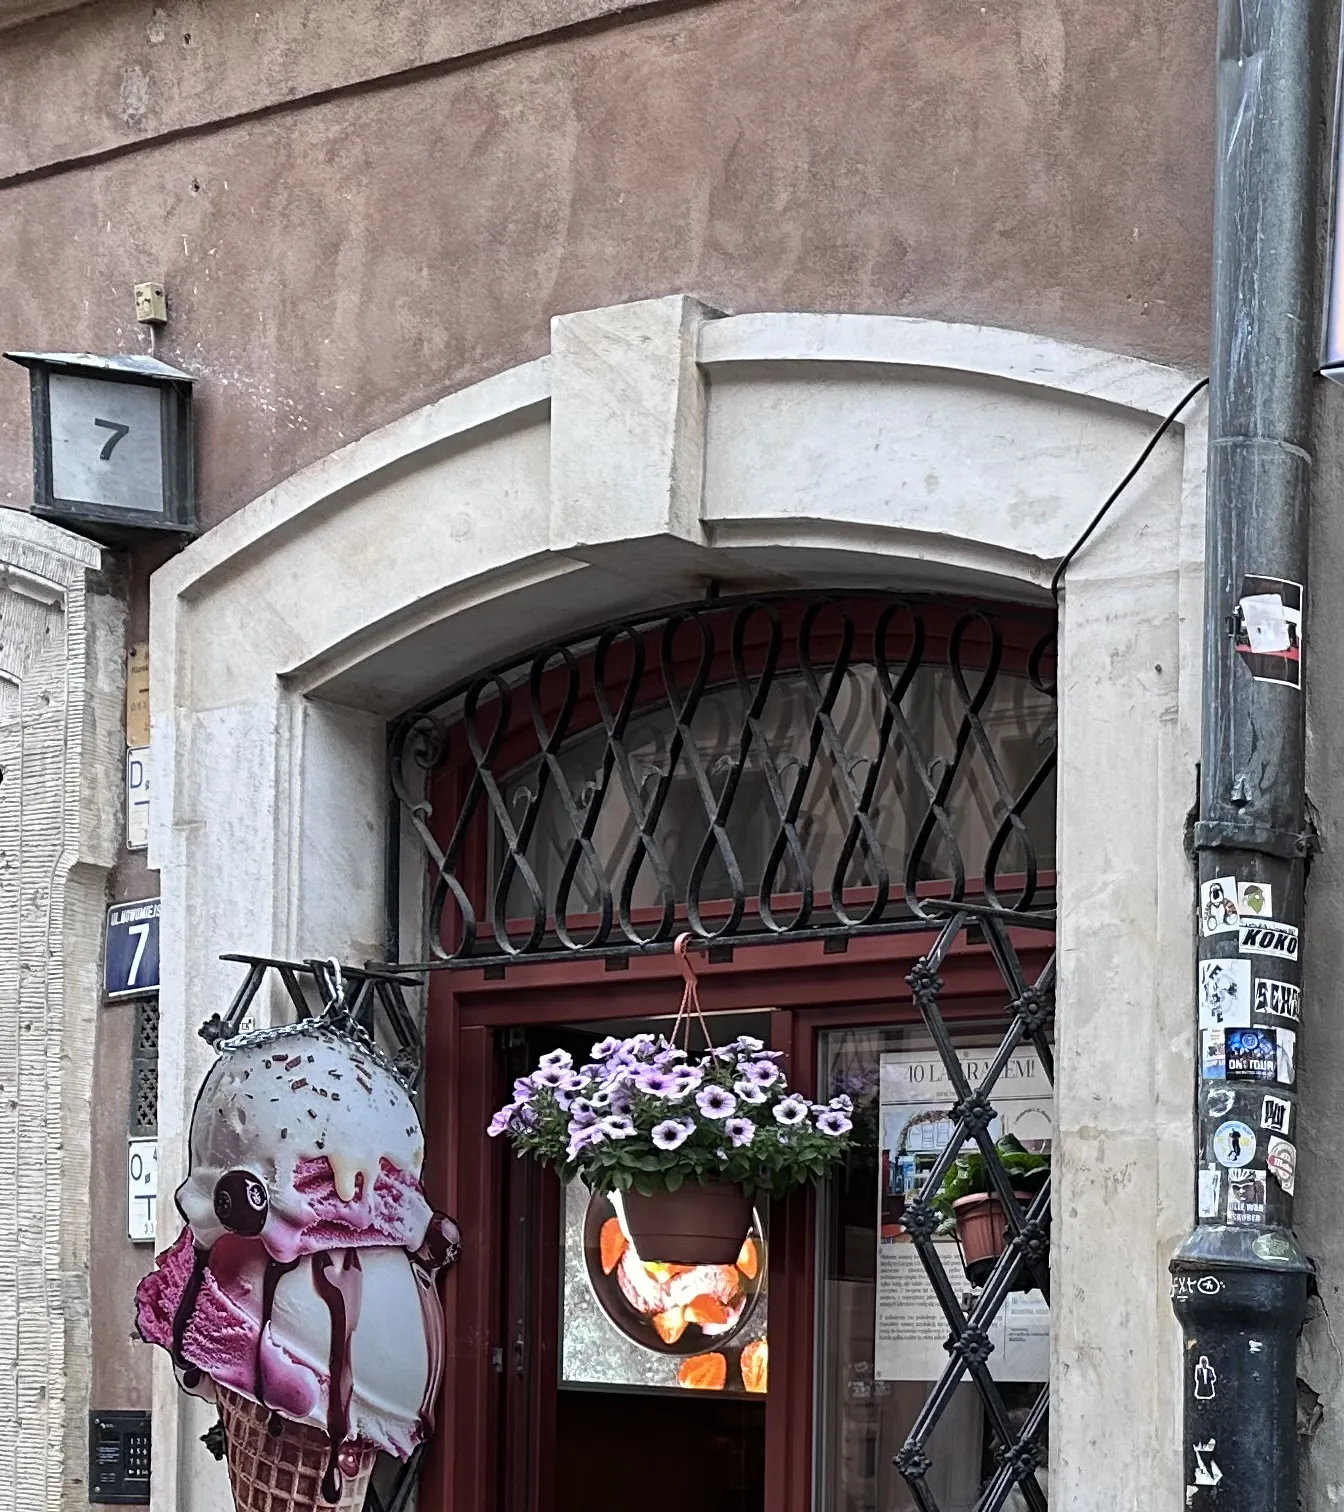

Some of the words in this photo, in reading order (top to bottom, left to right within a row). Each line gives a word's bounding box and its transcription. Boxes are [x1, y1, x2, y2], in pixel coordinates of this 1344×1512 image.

[94, 417, 130, 460] 7
[127, 922, 150, 986] 7
[1242, 928, 1298, 954] KOKO
